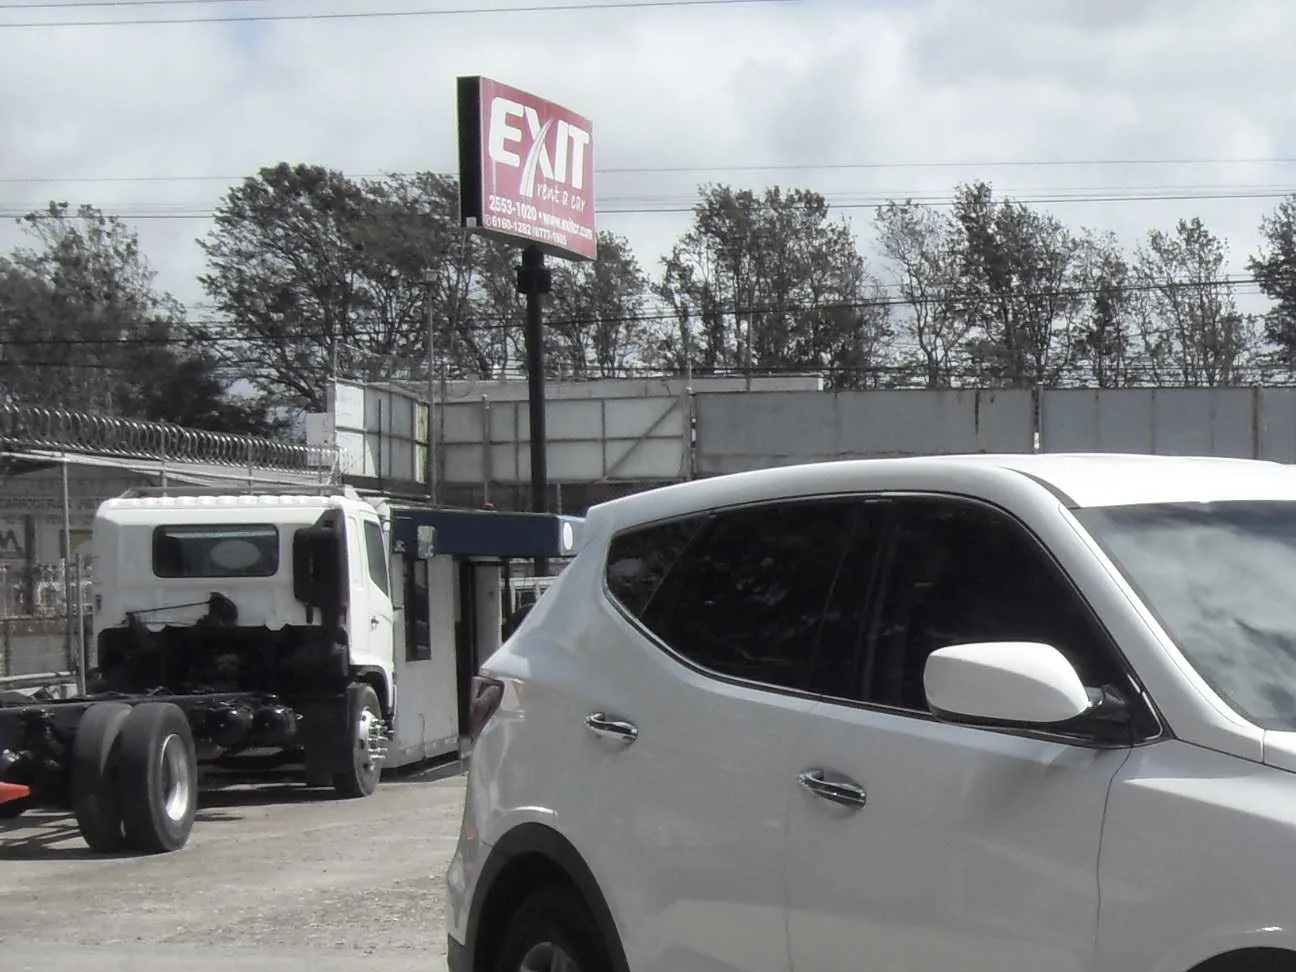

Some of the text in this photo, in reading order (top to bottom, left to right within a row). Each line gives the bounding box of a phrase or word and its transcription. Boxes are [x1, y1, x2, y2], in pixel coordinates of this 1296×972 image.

[489, 97, 590, 197] EXIT
[537, 183, 560, 203] rent
[571, 195, 586, 214] car
